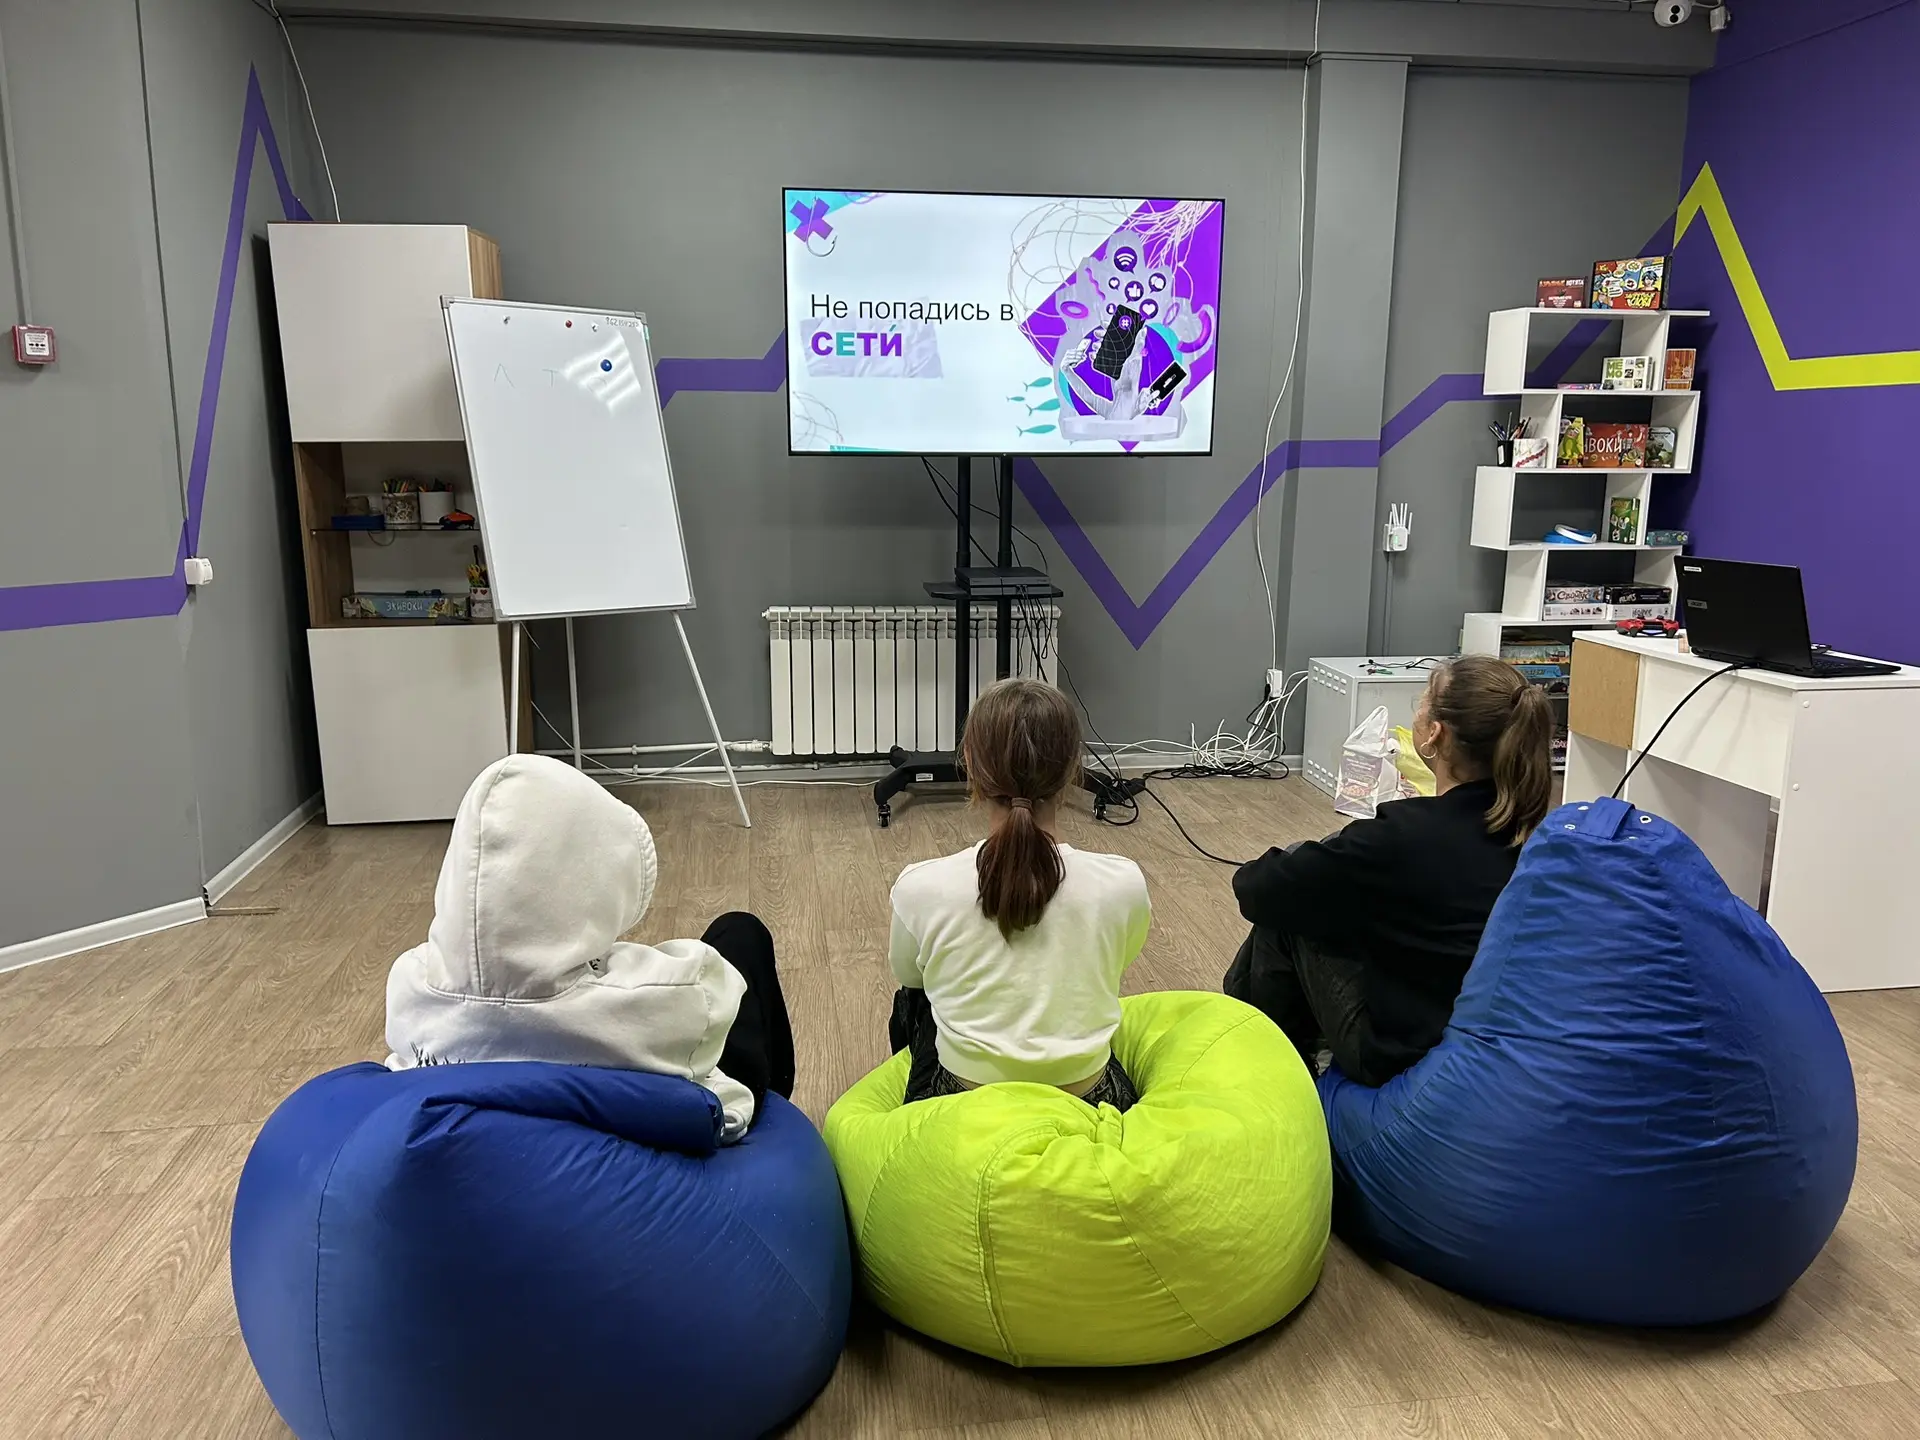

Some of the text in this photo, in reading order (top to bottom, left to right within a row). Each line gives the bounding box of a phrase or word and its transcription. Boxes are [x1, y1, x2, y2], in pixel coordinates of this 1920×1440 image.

[811, 294, 1014, 324] Не попадись в
